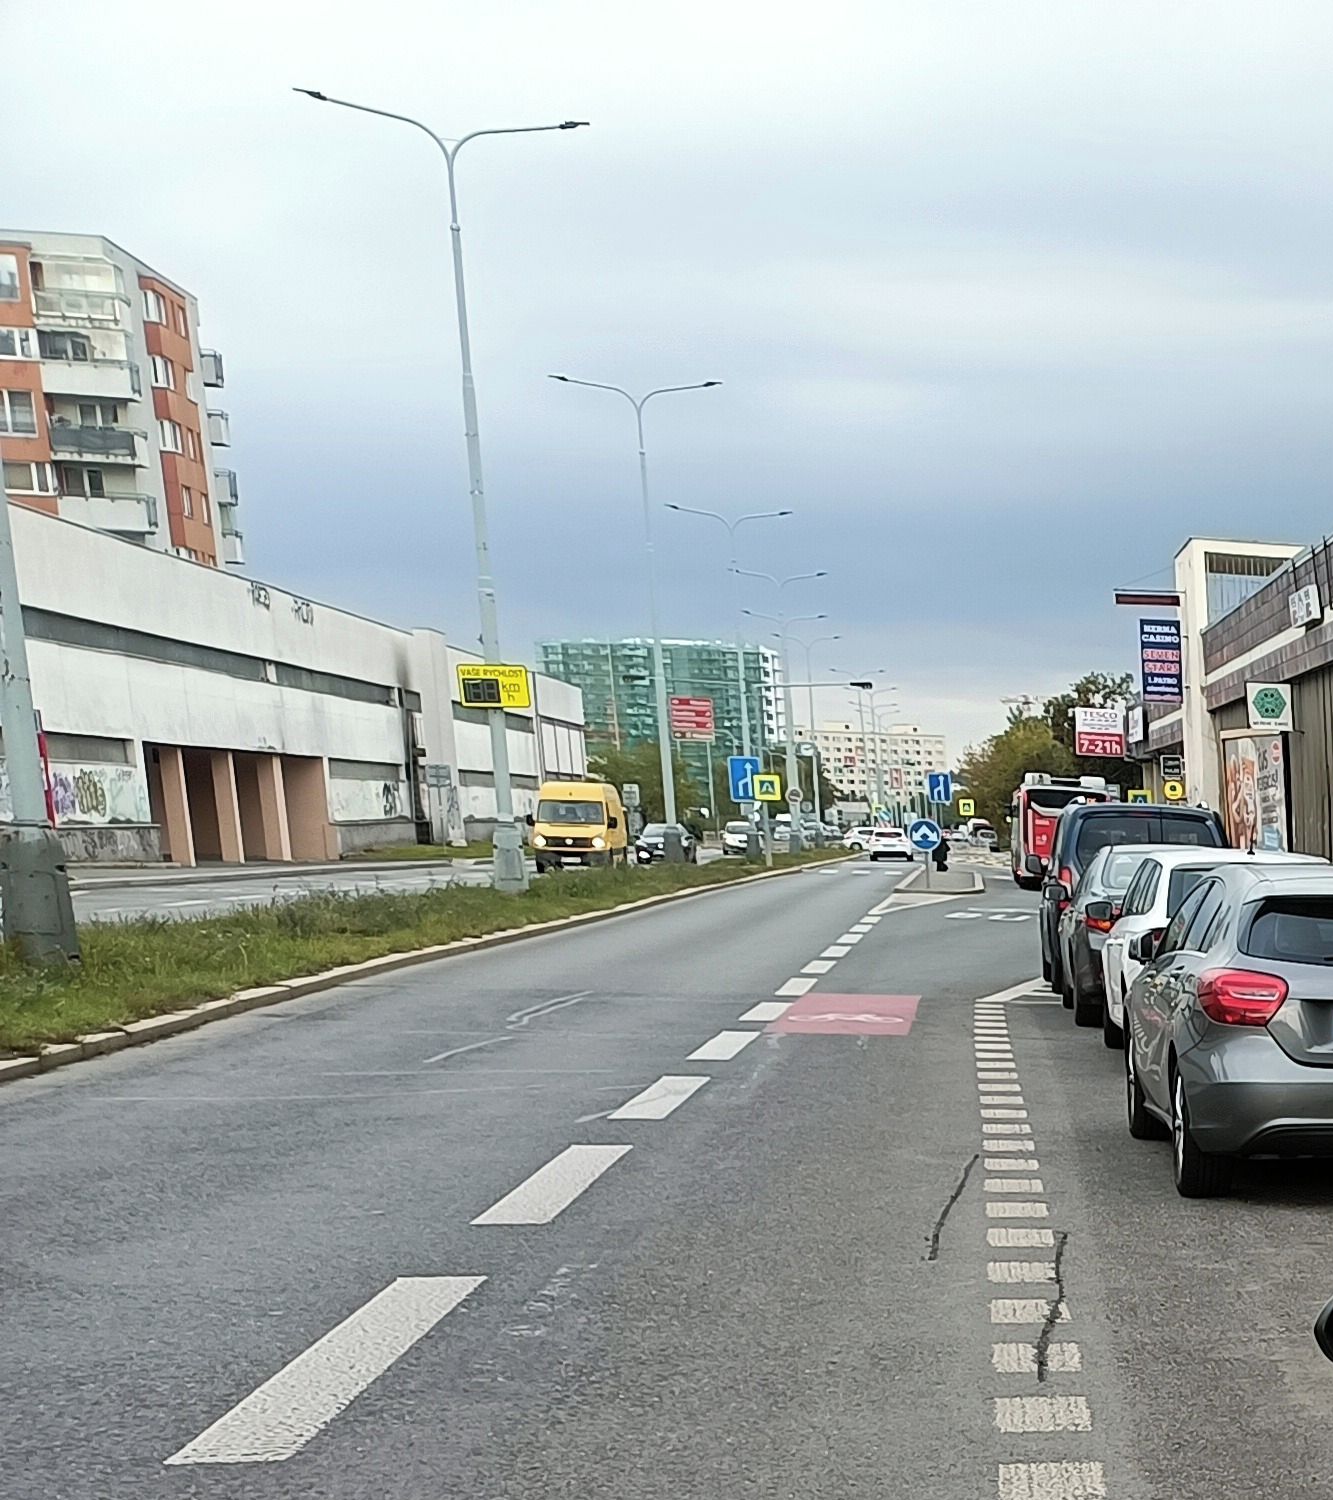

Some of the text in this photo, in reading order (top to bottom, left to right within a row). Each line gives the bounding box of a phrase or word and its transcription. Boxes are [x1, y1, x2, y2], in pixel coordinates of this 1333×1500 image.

[1142, 634, 1179, 643] CASINO
[1143, 649, 1179, 660] SEVEN
[483, 669, 522, 678] RYCHLOST
[1144, 662, 1179, 674] STARS
[501, 681, 520, 692] km
[1081, 711, 1117, 719] TESCO
[1080, 740, 1120, 754] 7-21h
